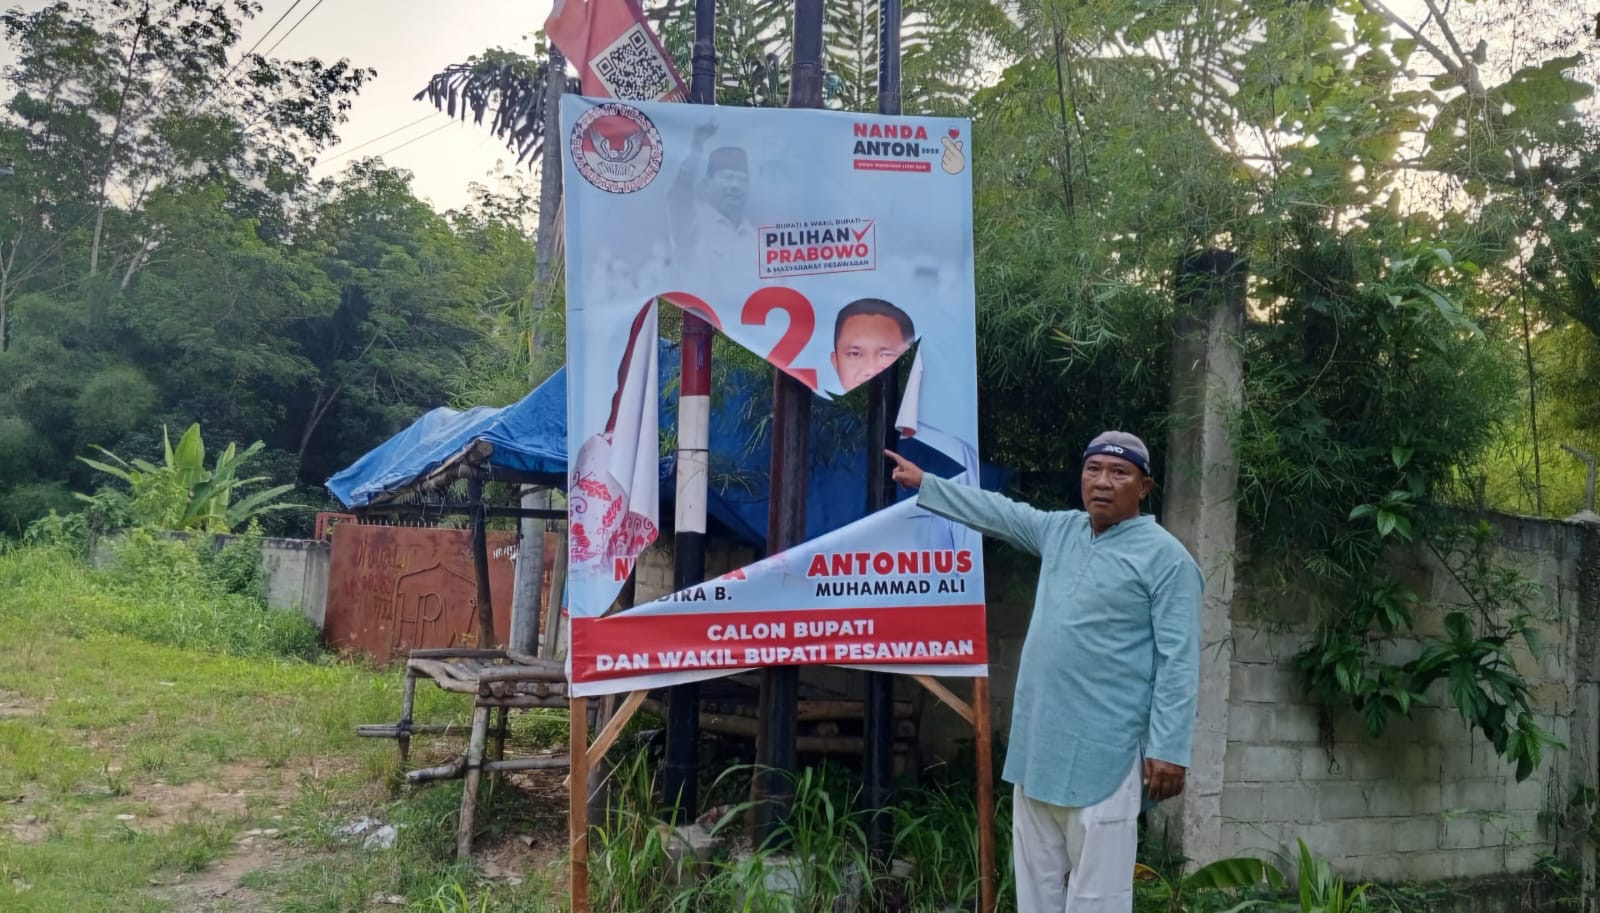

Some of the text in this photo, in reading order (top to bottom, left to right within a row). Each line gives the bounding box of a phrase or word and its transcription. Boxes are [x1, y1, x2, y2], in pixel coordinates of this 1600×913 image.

[853, 123, 928, 140] NANDA
[853, 140, 920, 158] ANTON
[836, 217, 861, 225] BUPATI
[766, 227, 850, 248] PILIHAN
[767, 243, 869, 265] PRABOWO
[807, 550, 973, 577] ANTONIUS
[715, 586, 732, 601] B.
[815, 579, 966, 597] MUHAMMAD ALI
[707, 619, 875, 641] CALON BUPATI
[596, 640, 974, 671] DAN WAKIL BUPATI PESAWARAN
